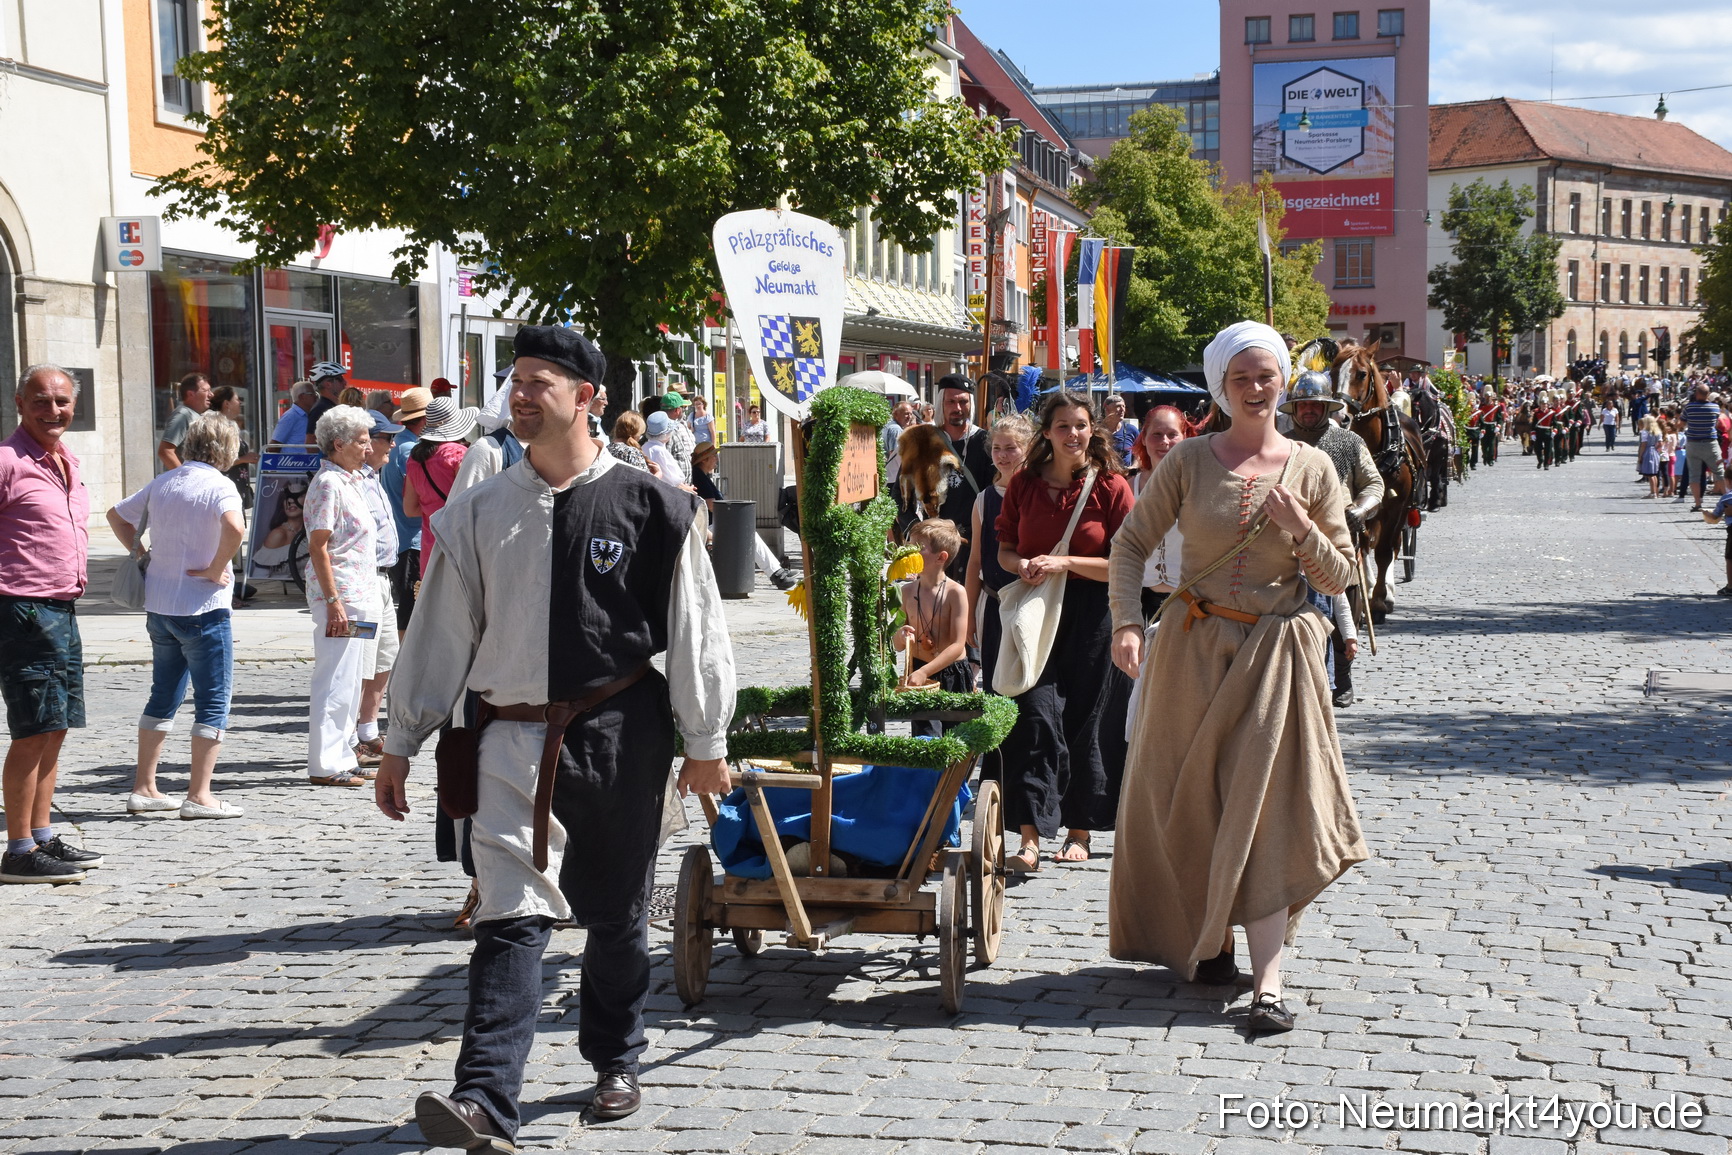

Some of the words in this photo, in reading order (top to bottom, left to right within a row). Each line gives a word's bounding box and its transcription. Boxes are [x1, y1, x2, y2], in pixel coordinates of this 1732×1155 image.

[1288, 90, 1309, 100] DIE
[1294, 136, 1353, 144] Neumarkt-Parsberg
[1282, 191, 1380, 212] sgezeichnet!
[728, 228, 834, 257] Pfalzgräfisches
[969, 190, 982, 290] CKEREI
[768, 260, 801, 274] Gefolge
[755, 274, 818, 295] Neumarkt
[1328, 302, 1376, 315] rkasse
[277, 455, 304, 467] Uhren
